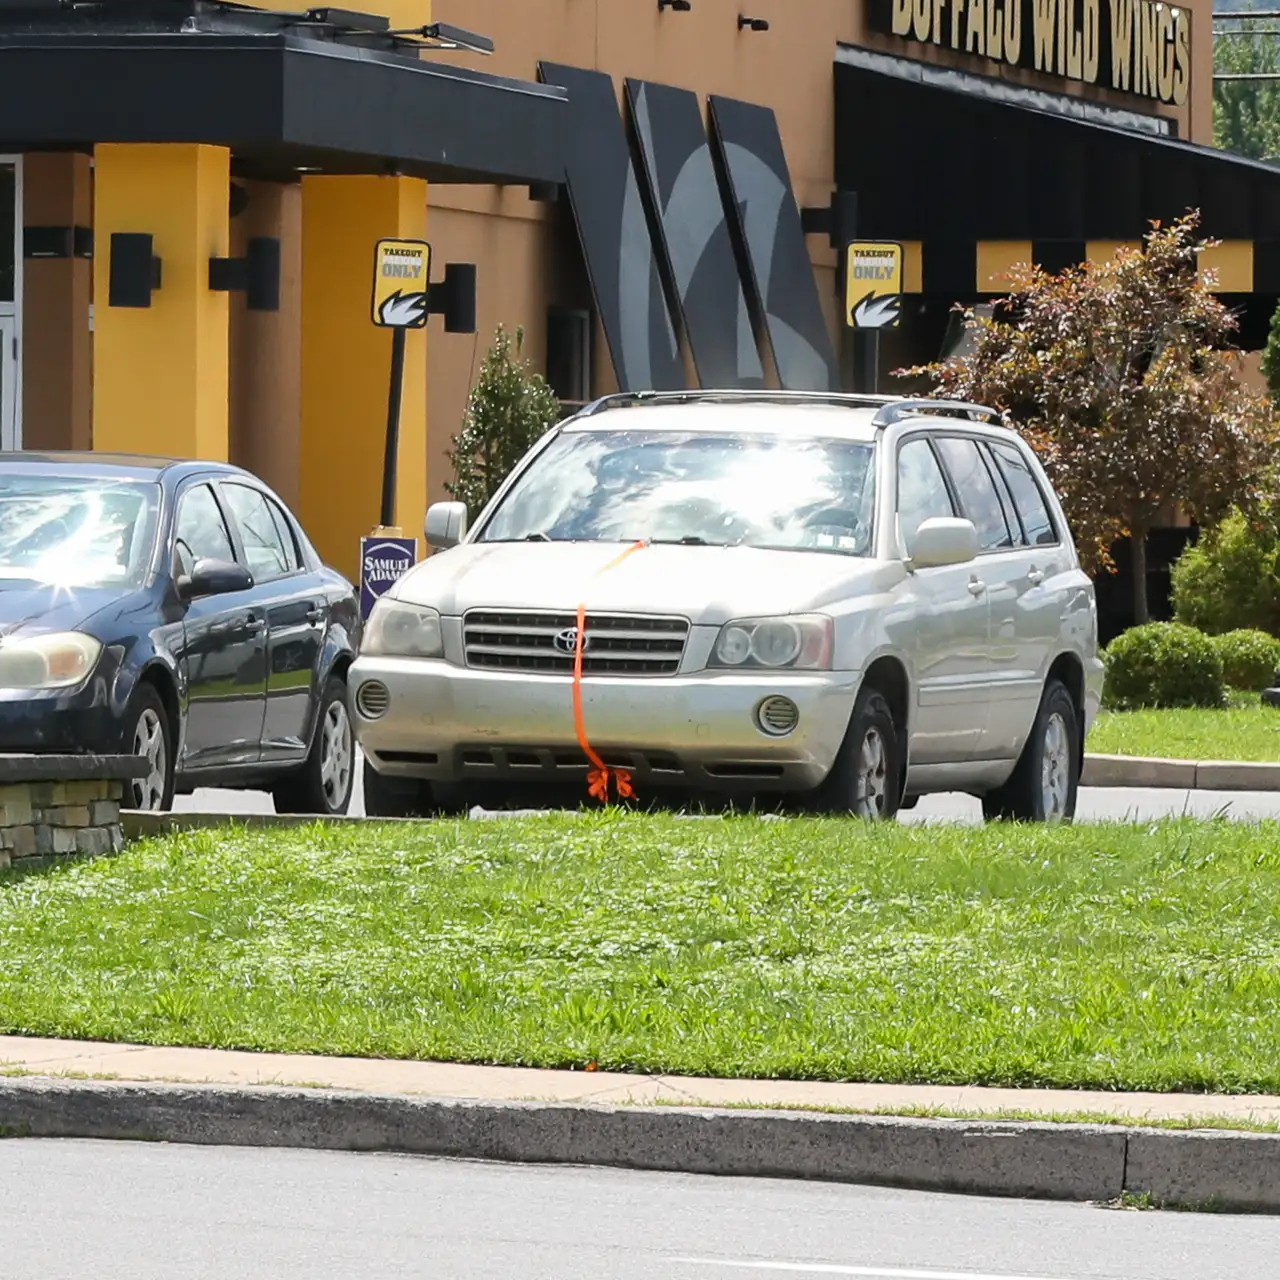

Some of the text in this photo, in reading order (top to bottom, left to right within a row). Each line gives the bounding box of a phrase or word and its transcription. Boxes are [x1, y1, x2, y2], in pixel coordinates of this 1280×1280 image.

[383, 248, 423, 257] TAKEOUT
[853, 249, 896, 258] TAKEOUT
[382, 264, 422, 278] ONLY
[853, 266, 895, 280] ONLY
[364, 556, 410, 571] SAMUEL
